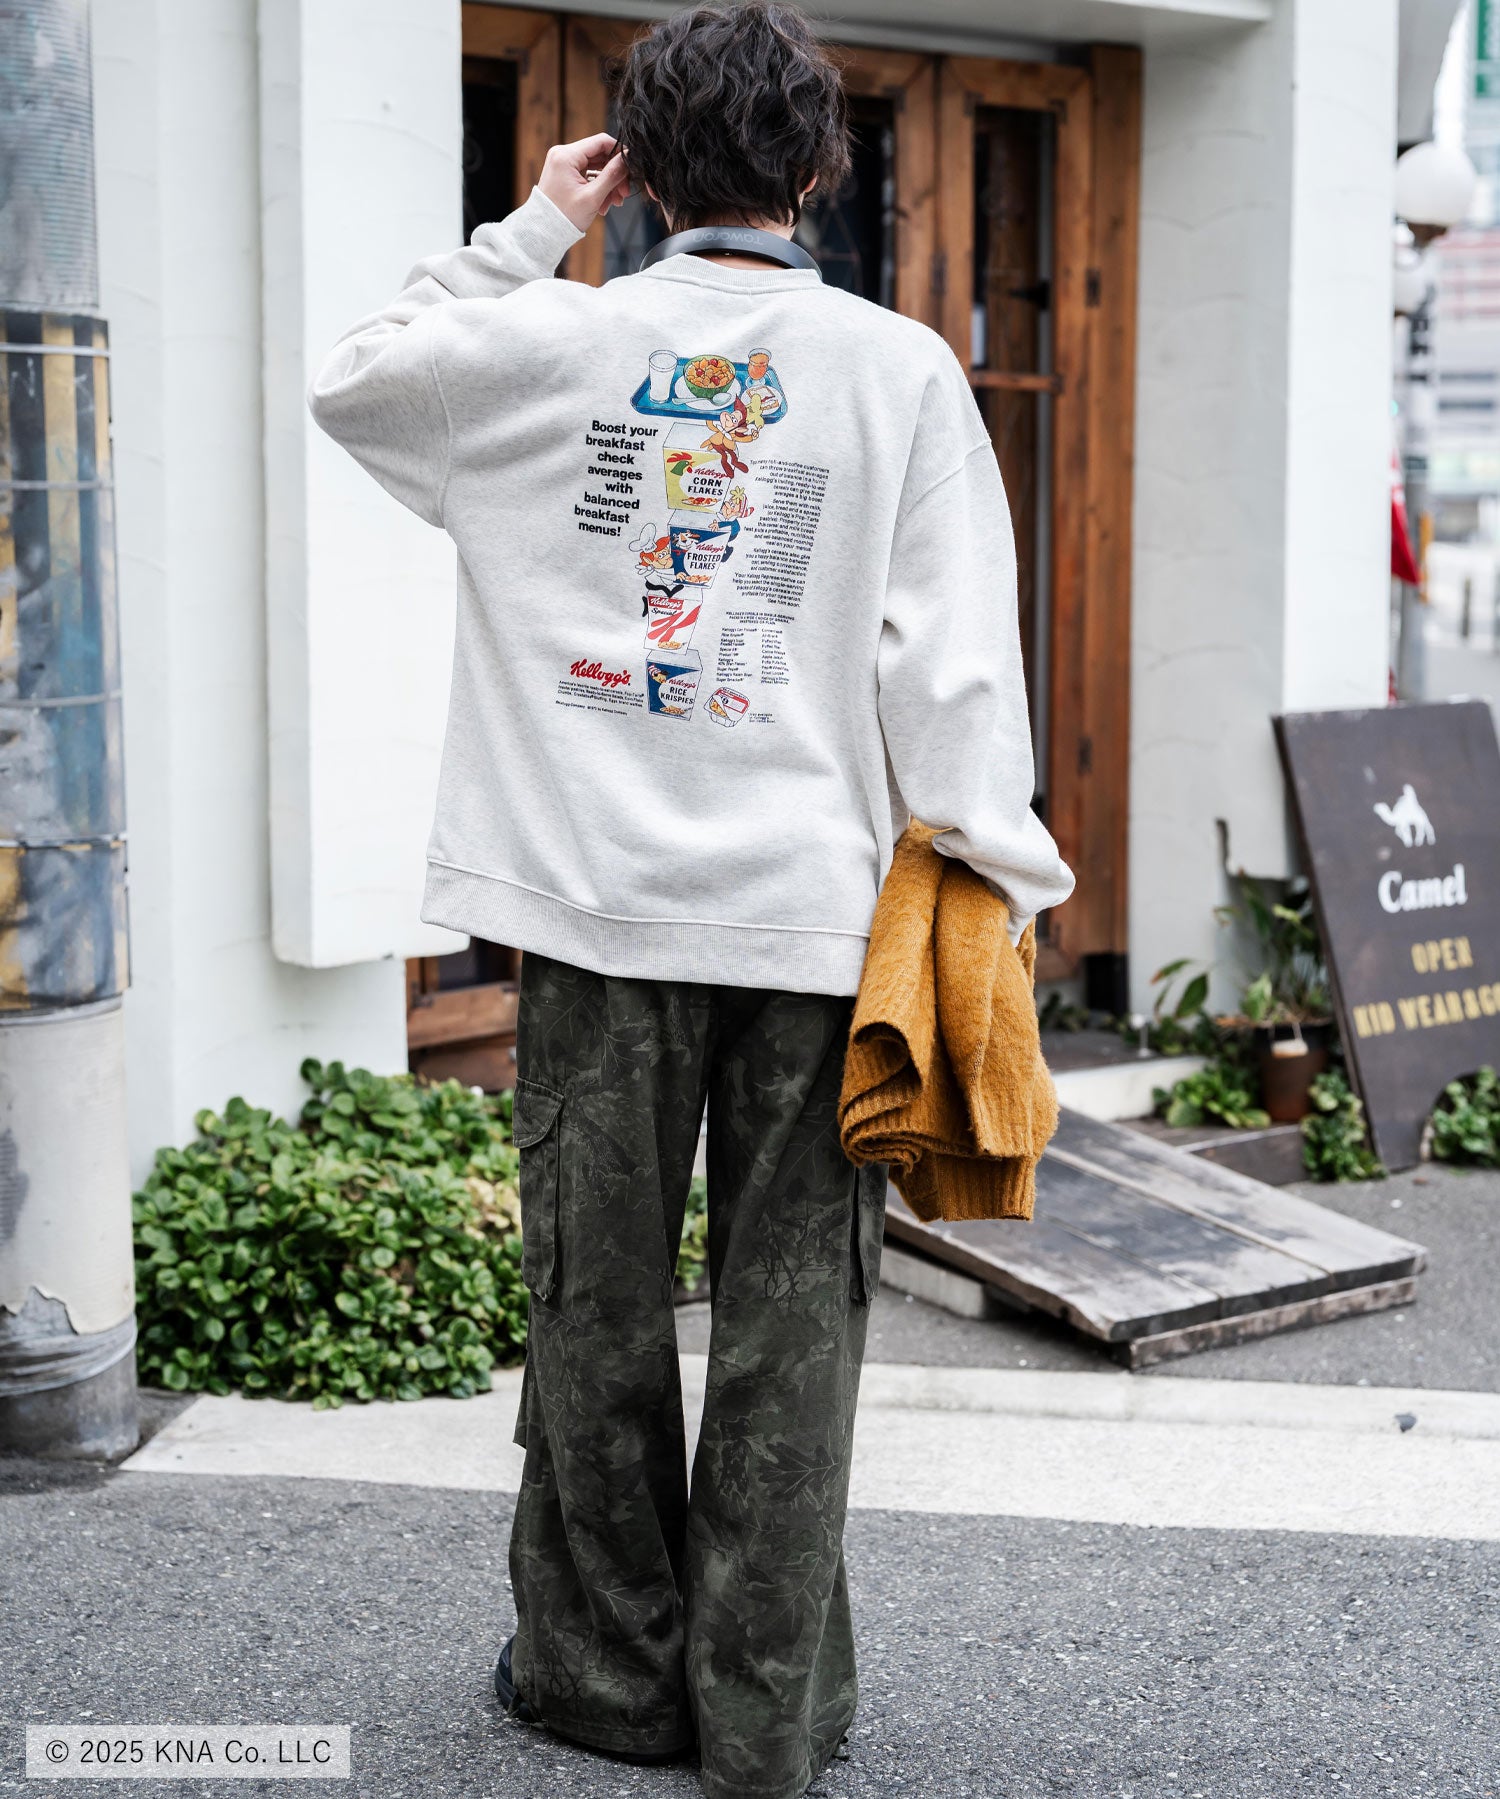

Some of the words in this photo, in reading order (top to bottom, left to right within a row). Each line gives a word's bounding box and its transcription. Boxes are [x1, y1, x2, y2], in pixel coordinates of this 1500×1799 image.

[592, 419, 627, 434] Boost
[629, 426, 658, 436] your
[585, 434, 646, 451] breakfast
[597, 451, 635, 465] check
[588, 466, 642, 480] averages
[605, 482, 633, 494] with
[694, 477, 722, 486] CORN
[688, 486, 724, 496] FLAKES
[584, 491, 640, 510] balanced
[574, 504, 630, 524] breakfast
[578, 522, 621, 536] menus!
[686, 552, 720, 562] FROSTED
[690, 561, 716, 570] FLAKES
[649, 598, 681, 608] Kellogg's
[652, 608, 677, 616] Special
[570, 658, 632, 688] Kellogg's
[668, 679, 696, 688] Kellogg's
[670, 686, 688, 696] RICE
[660, 692, 694, 705] KRISPIES
[1378, 863, 1467, 913] Camel
[1411, 936, 1473, 974] OPEN
